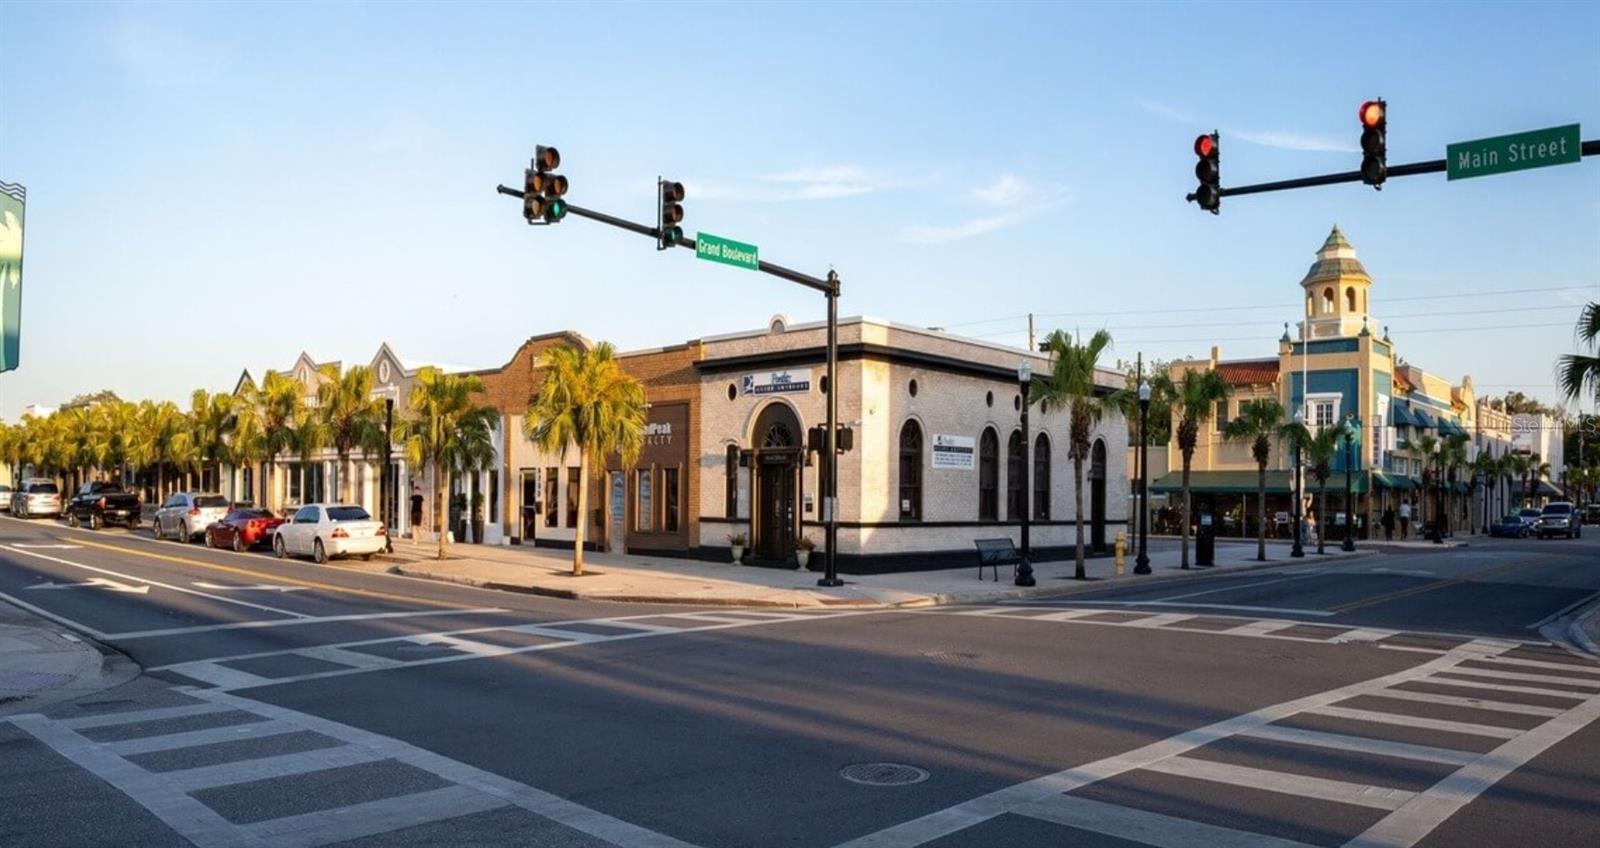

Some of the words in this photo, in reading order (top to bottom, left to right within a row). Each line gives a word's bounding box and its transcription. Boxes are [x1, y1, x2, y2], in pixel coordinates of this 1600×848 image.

[1458, 148, 1498, 170] Main
[1508, 136, 1567, 162] Street
[699, 238, 720, 257] Grand
[722, 244, 757, 265] Boulevard
